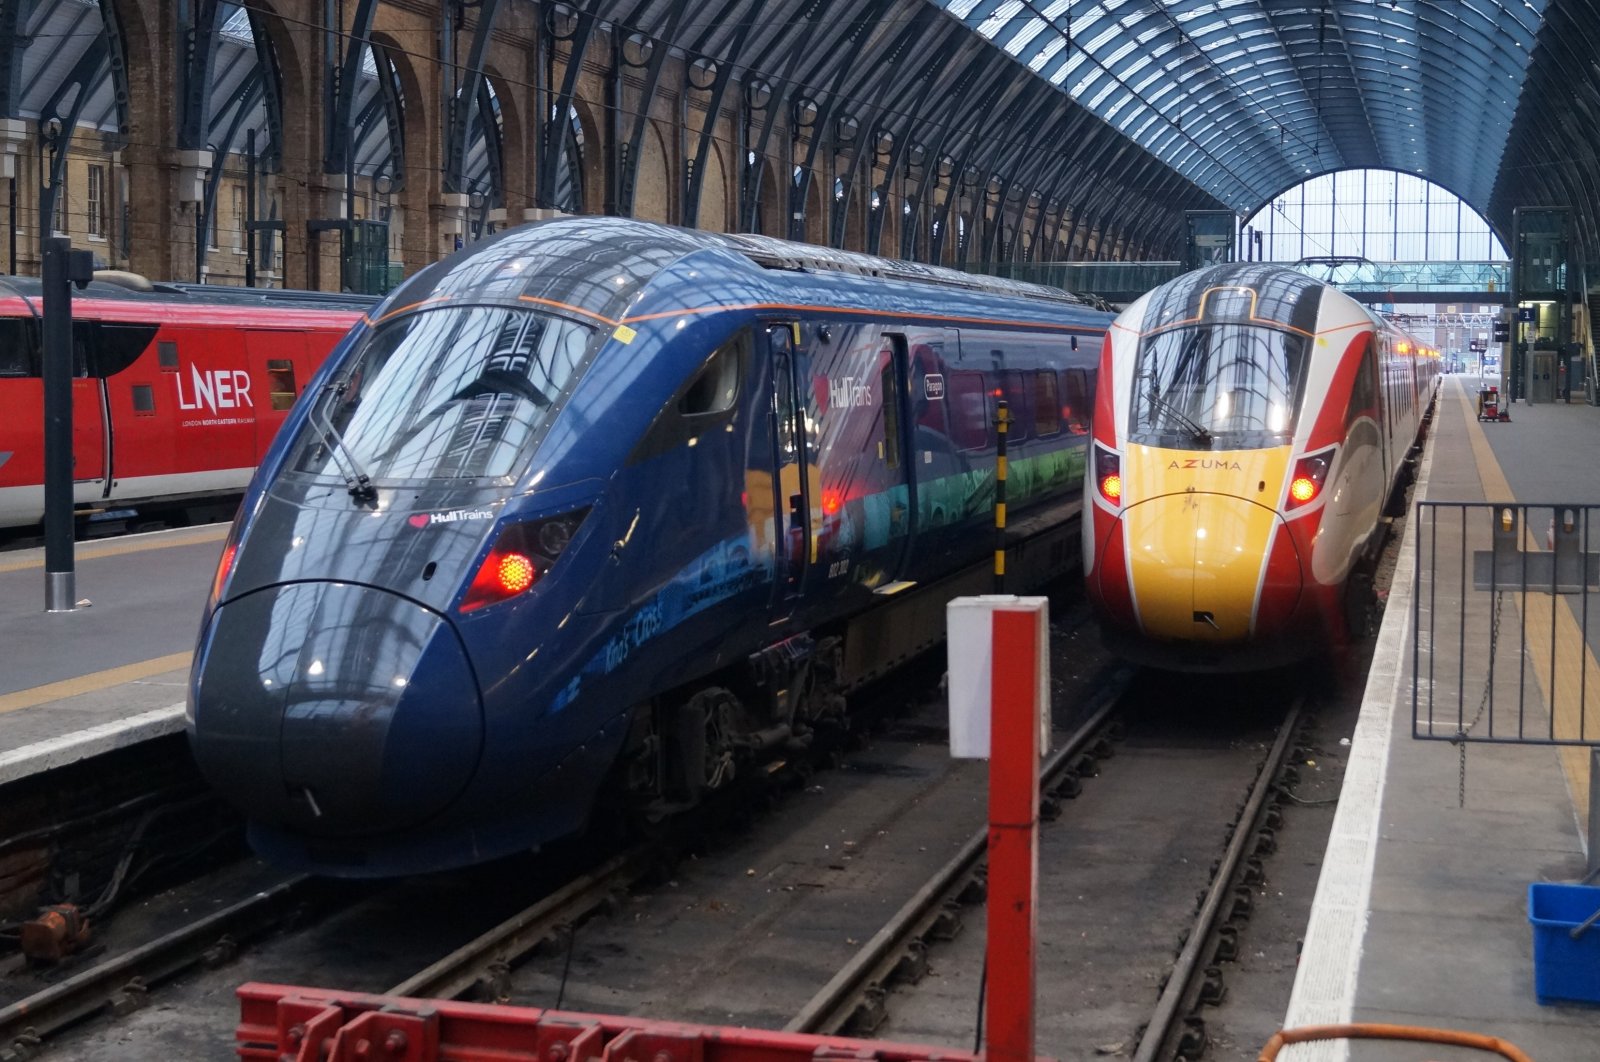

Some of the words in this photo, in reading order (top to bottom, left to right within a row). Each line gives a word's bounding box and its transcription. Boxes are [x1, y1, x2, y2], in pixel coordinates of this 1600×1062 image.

[1524, 310, 1531, 319] 1
[176, 361, 253, 416] LNER
[926, 379, 943, 395] Paragon
[182, 419, 202, 427] LONDON
[202, 418, 217, 426] NORTH
[1168, 459, 1241, 471] AZUMA
